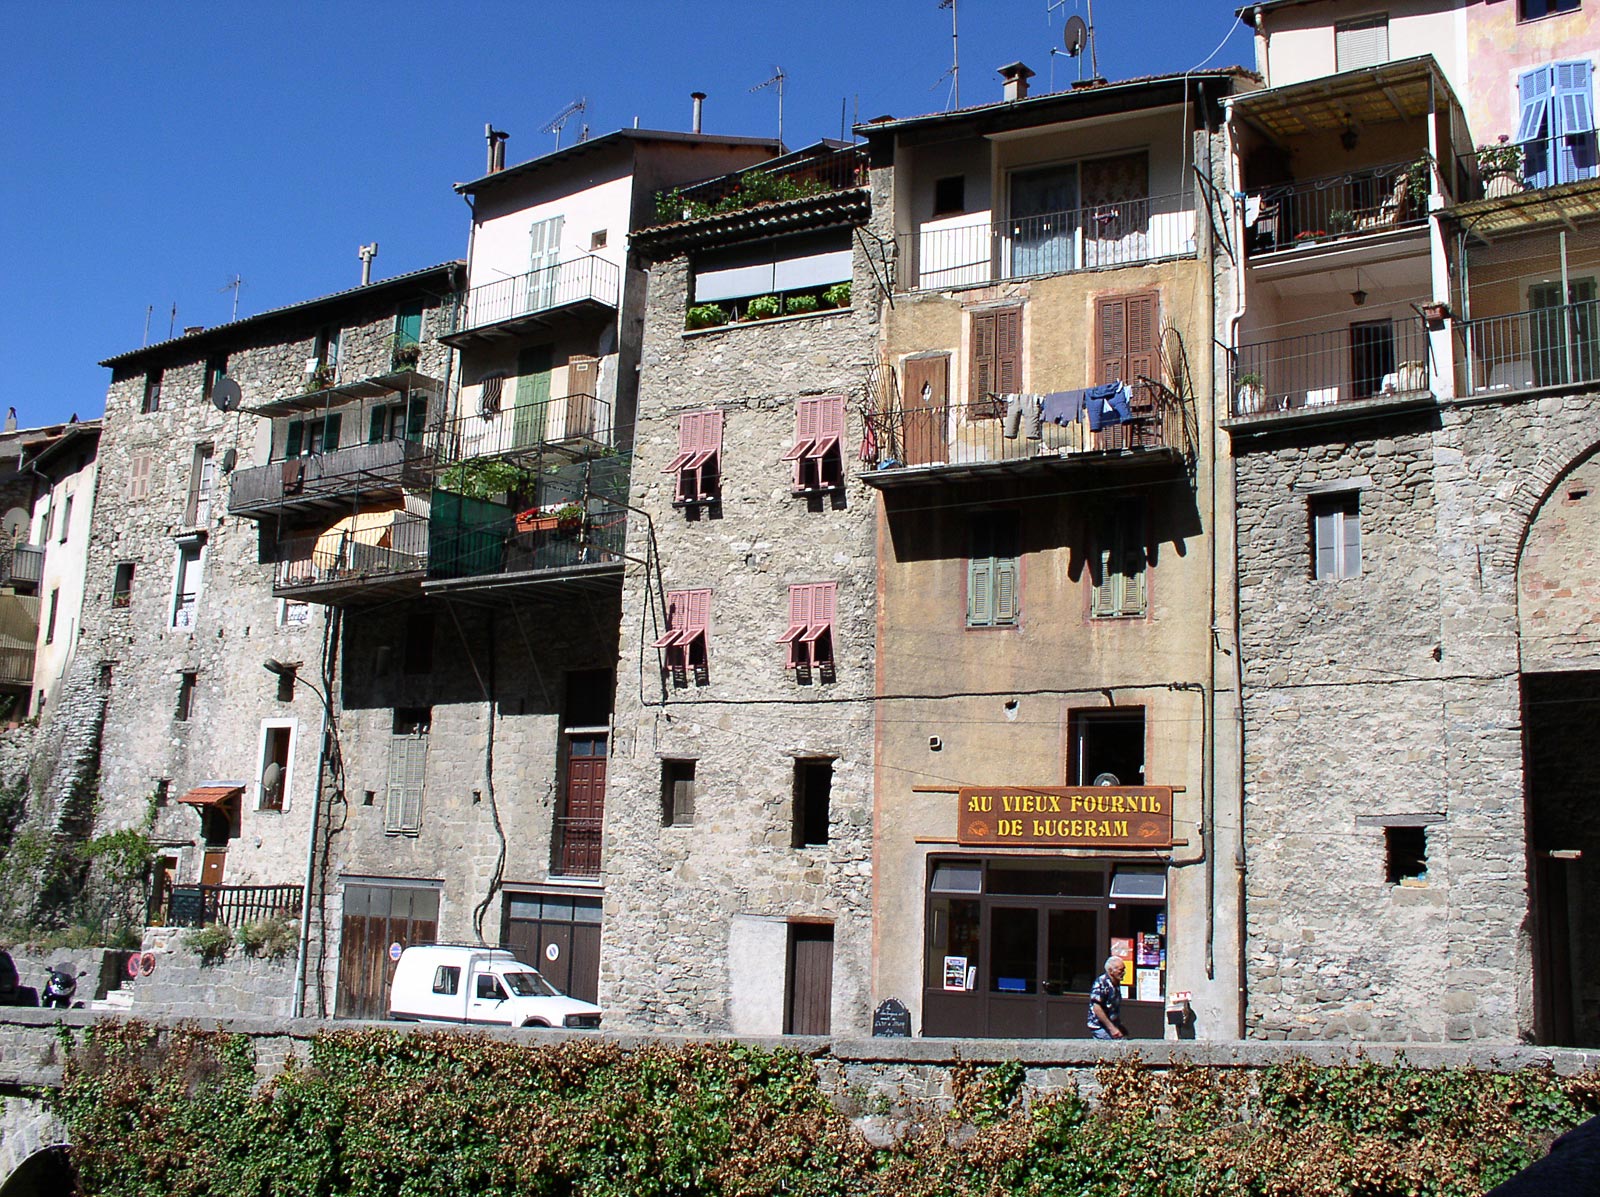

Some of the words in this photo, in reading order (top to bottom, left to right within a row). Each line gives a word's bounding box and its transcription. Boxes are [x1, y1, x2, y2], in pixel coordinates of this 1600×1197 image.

[968, 795, 992, 812] AU
[1002, 795, 1061, 812] VIEUX
[1070, 795, 1162, 813] FOURNIL
[997, 819, 1023, 837] DE
